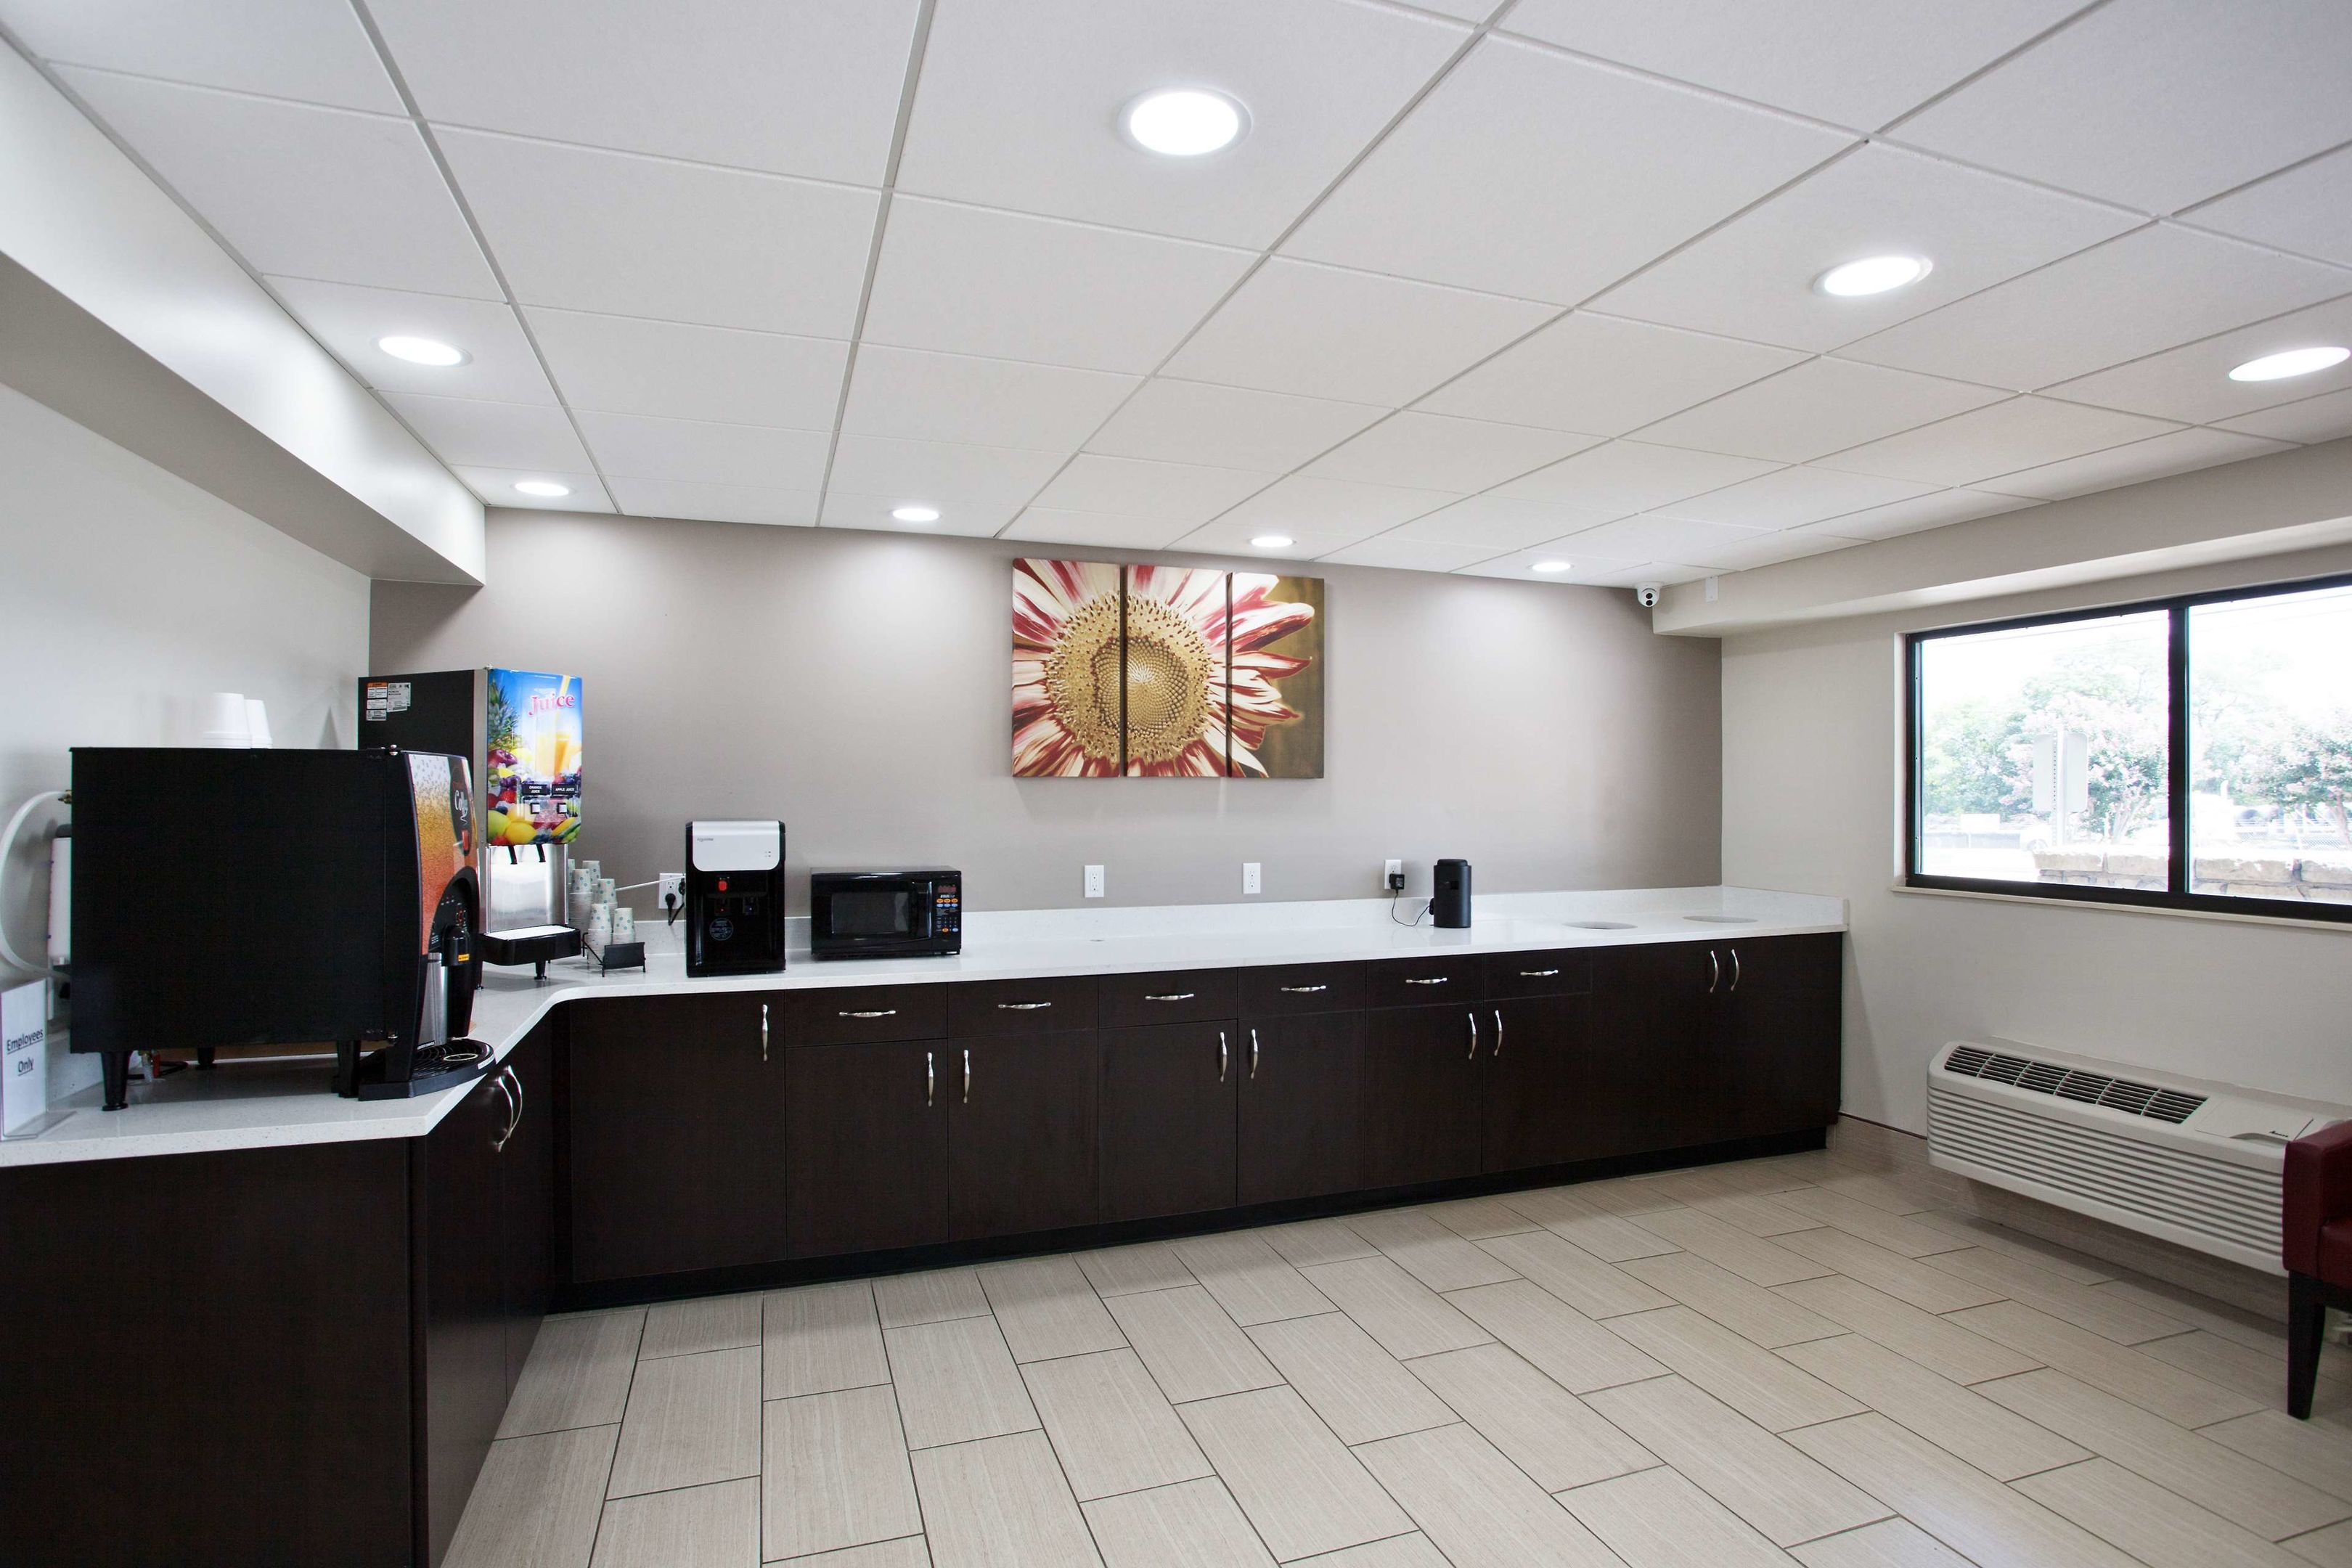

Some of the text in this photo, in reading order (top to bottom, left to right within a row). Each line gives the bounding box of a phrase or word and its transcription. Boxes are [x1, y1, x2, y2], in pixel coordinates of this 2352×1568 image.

[528, 693, 575, 716] Juice
[7, 1029, 44, 1051] Employees
[18, 1057, 34, 1073] Only
